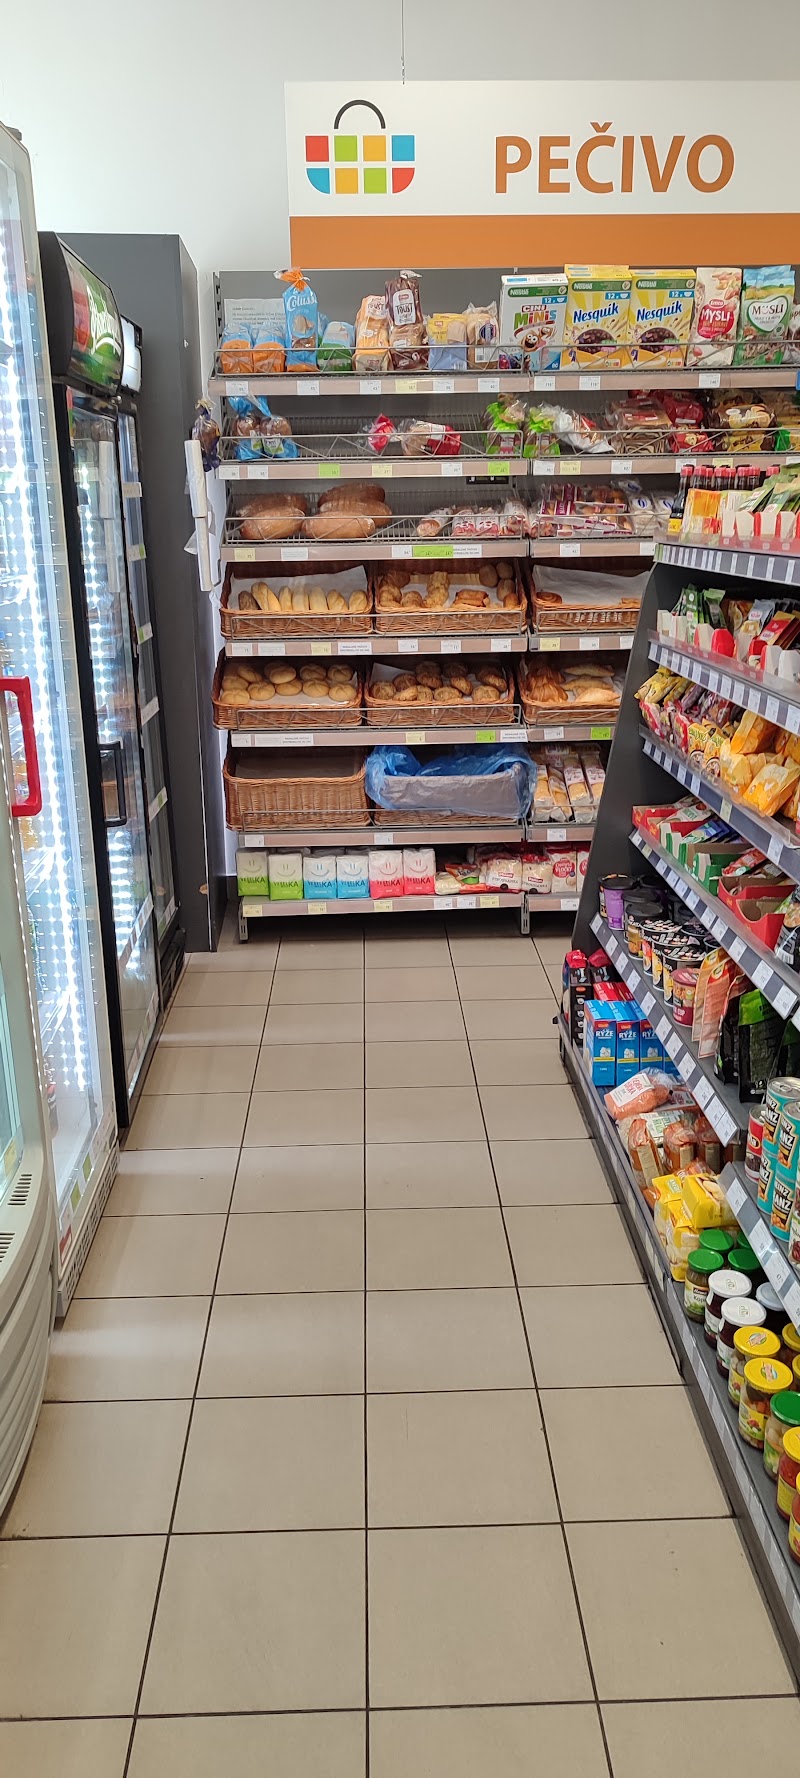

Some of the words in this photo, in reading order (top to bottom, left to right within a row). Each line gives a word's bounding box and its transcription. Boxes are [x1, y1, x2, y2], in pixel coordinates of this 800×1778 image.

[494, 121, 735, 194] PEČIVO
[573, 302, 619, 323] Nesquik
[636, 300, 682, 322] Nesquik
[701, 308, 730, 323] MYSLI
[595, 1029, 614, 1037] RÝŽE
[618, 1030, 637, 1039] RÝŽE
